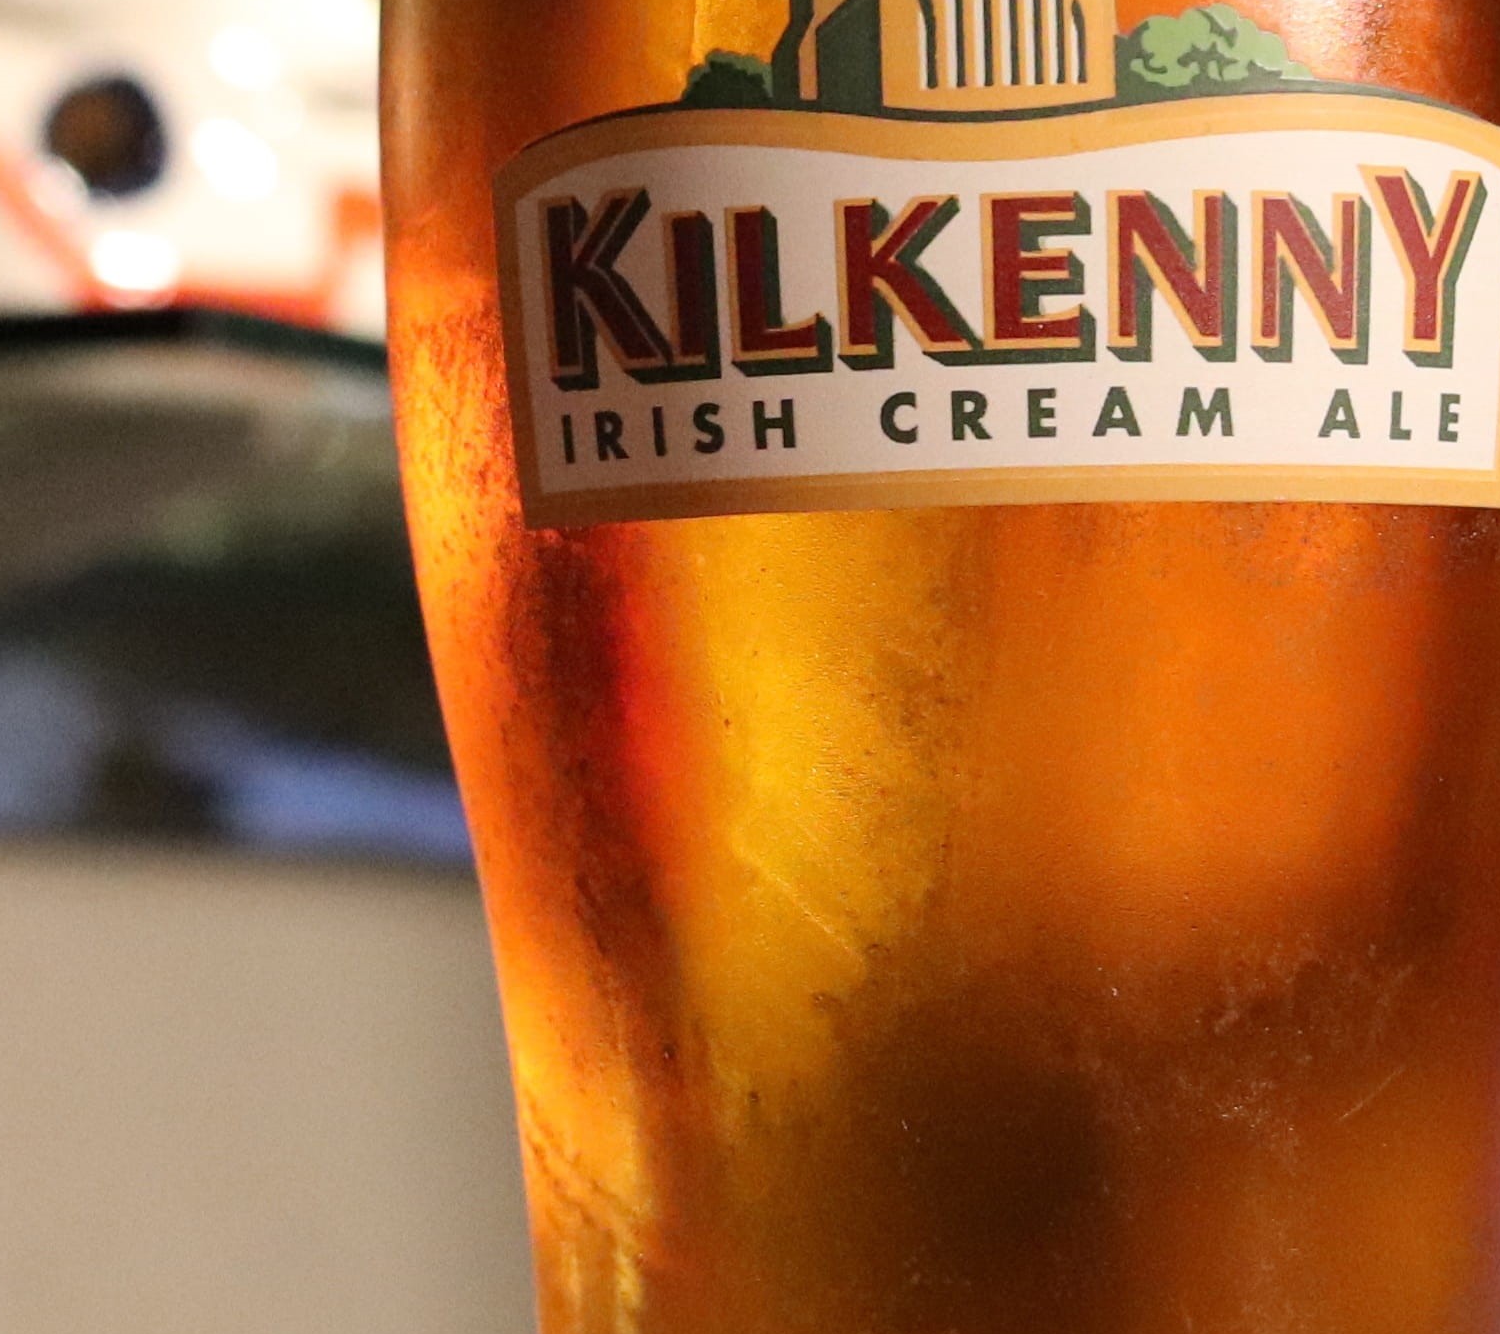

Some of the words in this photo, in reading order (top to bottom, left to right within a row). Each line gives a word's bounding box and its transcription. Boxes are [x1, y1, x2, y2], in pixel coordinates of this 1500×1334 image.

[542, 164, 1487, 390] KILKENNY
[562, 397, 797, 465] IRISH
[879, 386, 1235, 445] CREAM
[1318, 388, 1461, 444] ALE
